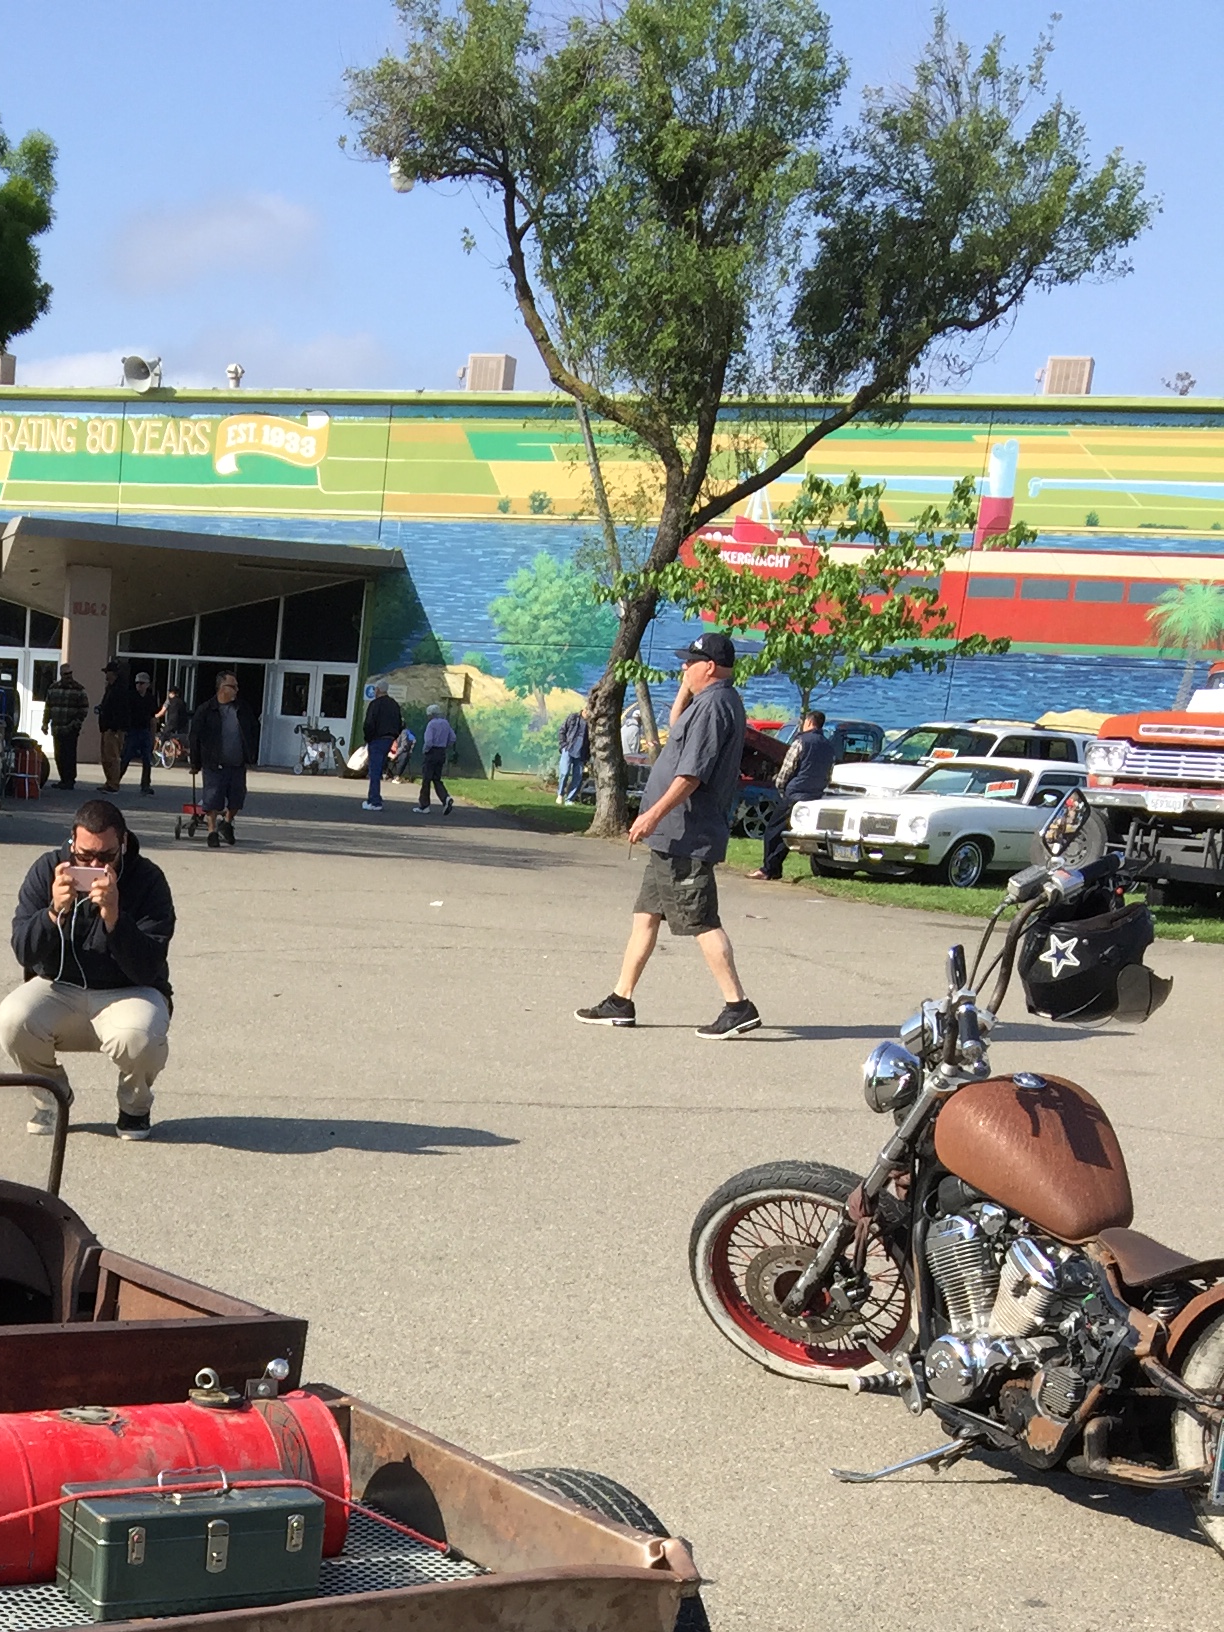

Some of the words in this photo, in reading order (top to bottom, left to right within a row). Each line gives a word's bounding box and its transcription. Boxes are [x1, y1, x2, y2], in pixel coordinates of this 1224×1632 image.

[86, 417, 117, 454] 80
[128, 419, 210, 455] YEARS
[262, 425, 316, 457] 1933
